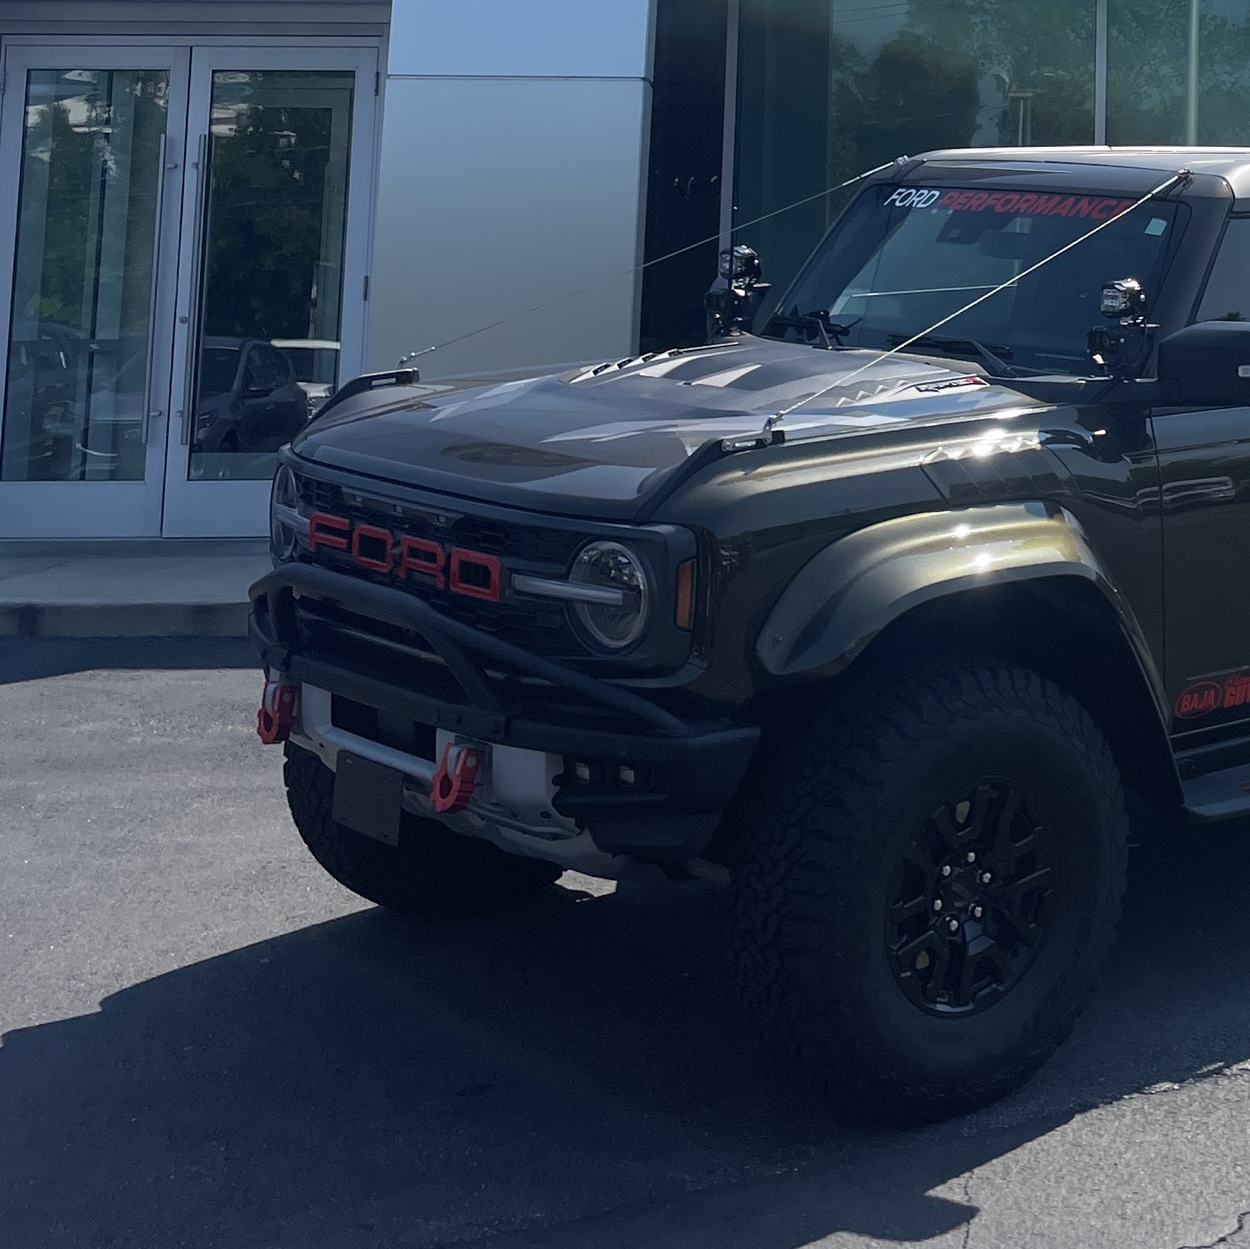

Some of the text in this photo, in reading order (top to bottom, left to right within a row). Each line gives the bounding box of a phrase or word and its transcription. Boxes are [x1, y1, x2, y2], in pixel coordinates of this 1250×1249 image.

[883, 188, 1138, 221] FORD PERFORMANCE
[309, 511, 501, 603] FORD
[1180, 688, 1216, 714] BAJA
